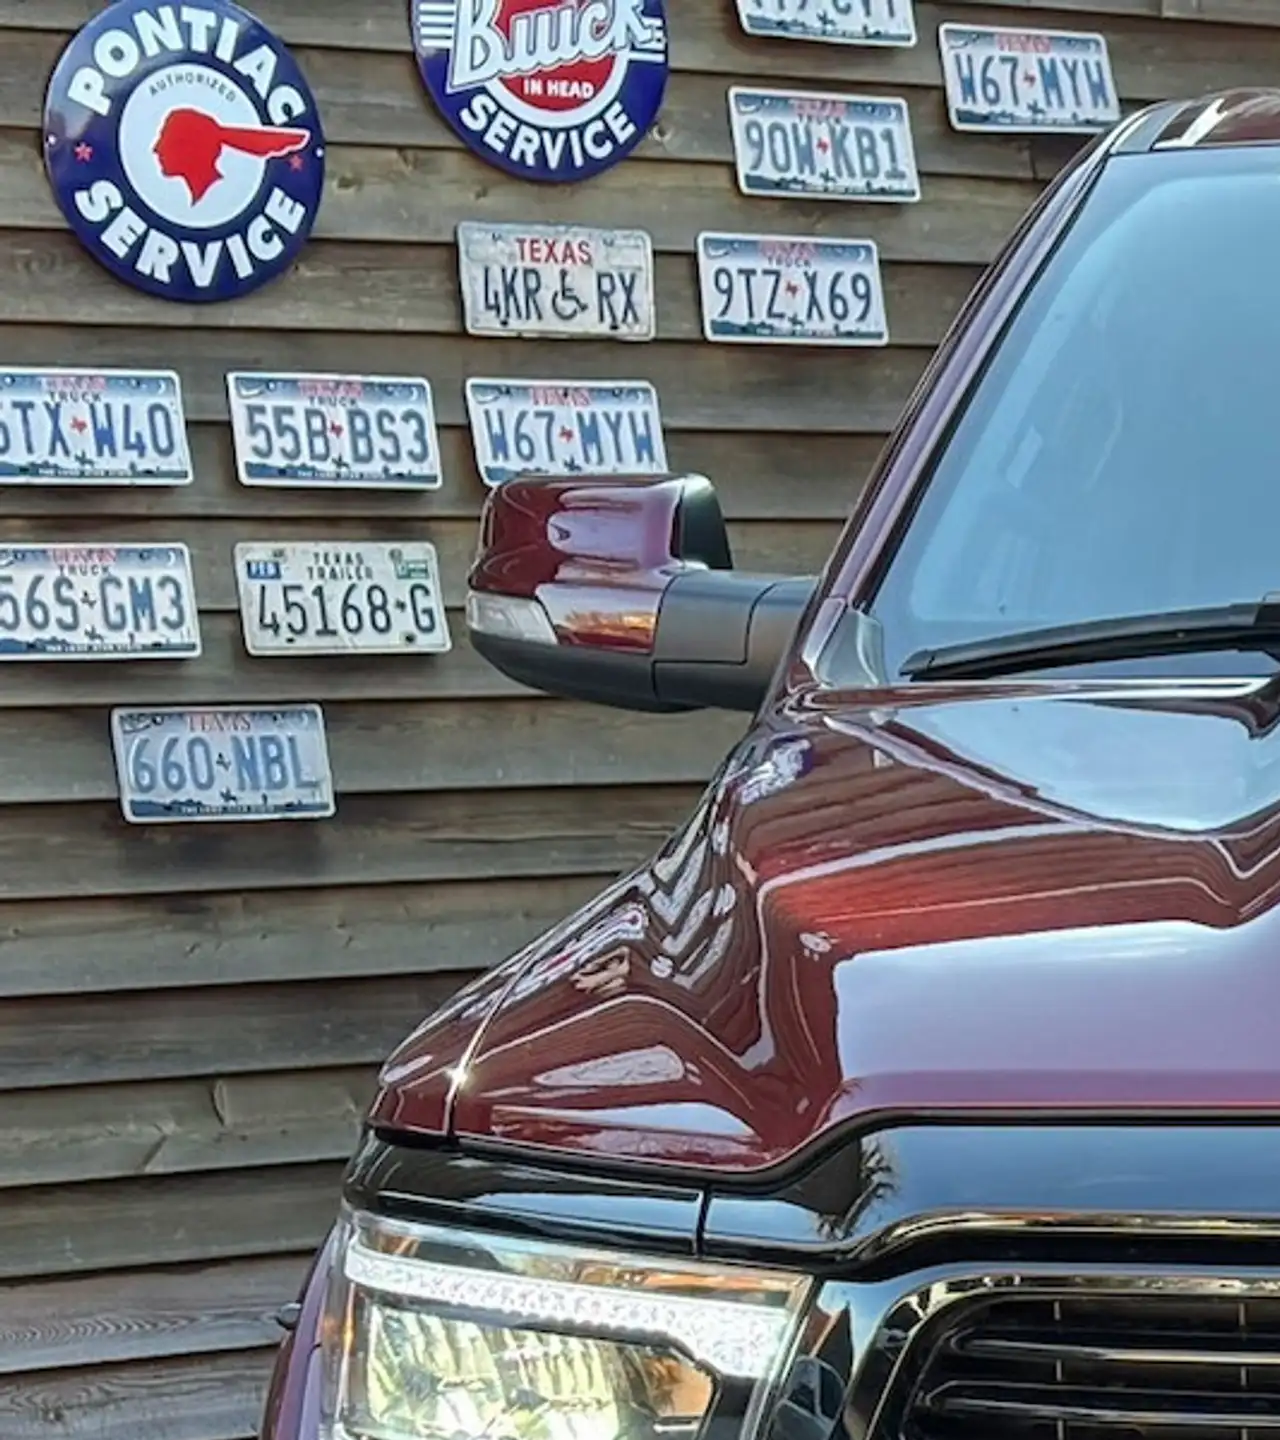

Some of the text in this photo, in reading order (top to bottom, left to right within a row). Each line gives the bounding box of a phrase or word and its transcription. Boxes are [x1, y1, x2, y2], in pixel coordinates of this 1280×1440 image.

[68, 5, 306, 126] PONTIAC
[449, 0, 653, 90] Buick
[148, 71, 237, 103] AUTHORIZED
[523, 79, 595, 99] IN HEAD
[459, 94, 638, 170] SERVICE
[827, 121, 906, 181] KB1
[74, 180, 306, 288] SERVICE
[515, 237, 593, 267] TEXAS
[484, 265, 641, 325] 4KR RX
[714, 267, 871, 322] 9TZ X69
[246, 404, 430, 464] 55B BS3
[58, 564, 112, 577] TRUCK
[307, 566, 374, 581] TRAILER
[313, 552, 365, 566] TEXAS
[100, 575, 186, 632] GM3
[260, 583, 436, 637] 45168 G
[187, 713, 252, 732] TEXAS
[230, 733, 321, 792] NBL
